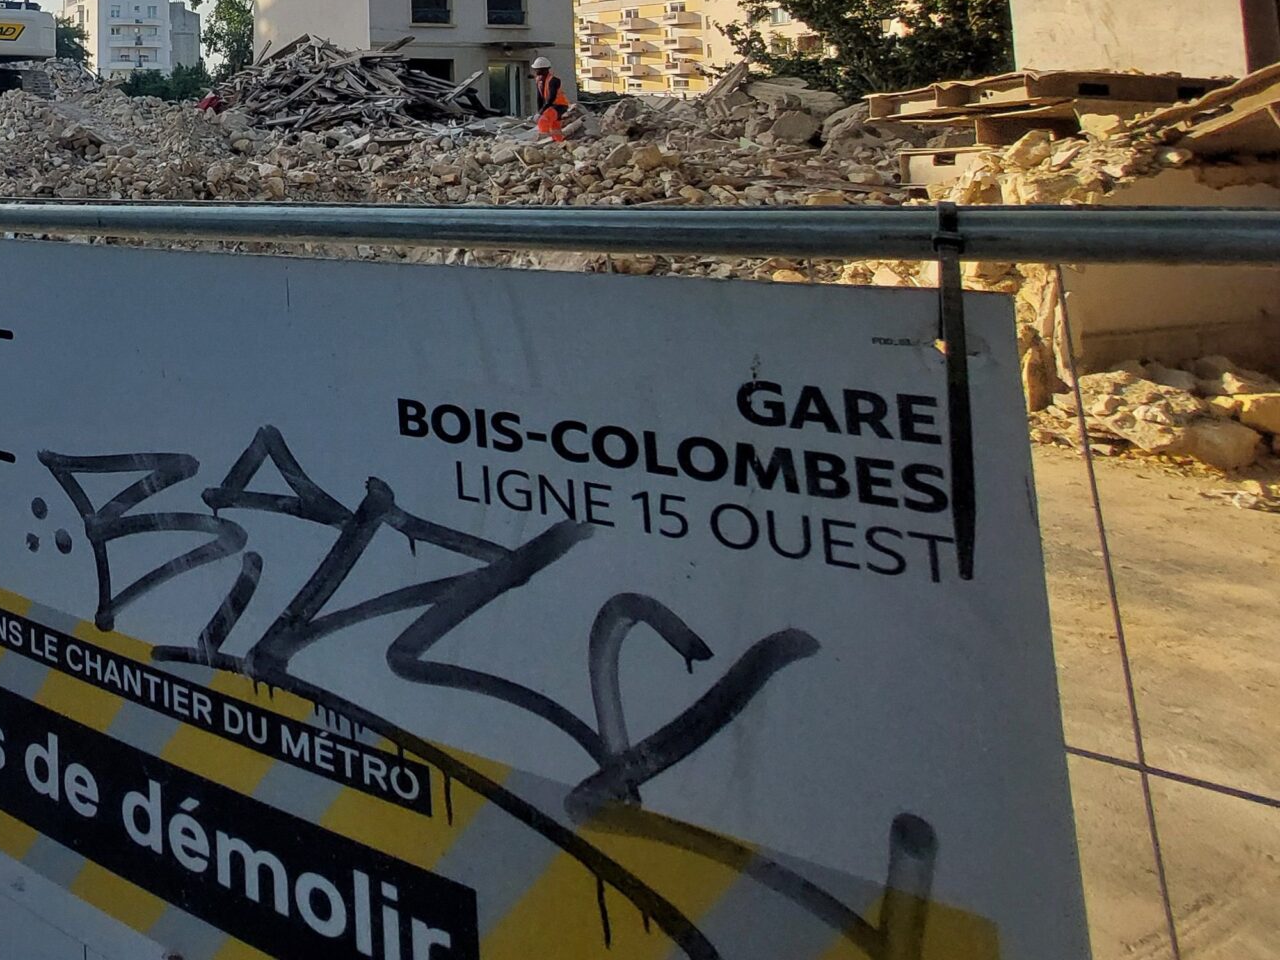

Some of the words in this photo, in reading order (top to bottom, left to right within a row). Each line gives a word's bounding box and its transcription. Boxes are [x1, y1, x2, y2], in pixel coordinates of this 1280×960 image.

[396, 397, 950, 514] BOIS-COLOMBES
[736, 380, 943, 445] GARE
[455, 460, 615, 528] LIGNE
[631, 490, 689, 539] 15
[709, 502, 955, 583] OUEST
[30, 631, 59, 663] LE
[65, 643, 213, 727] CHANTIER
[223, 702, 268, 745] DU
[280, 724, 421, 800] MÉTRO
[24, 732, 101, 818] de
[121, 780, 452, 960] démolir
